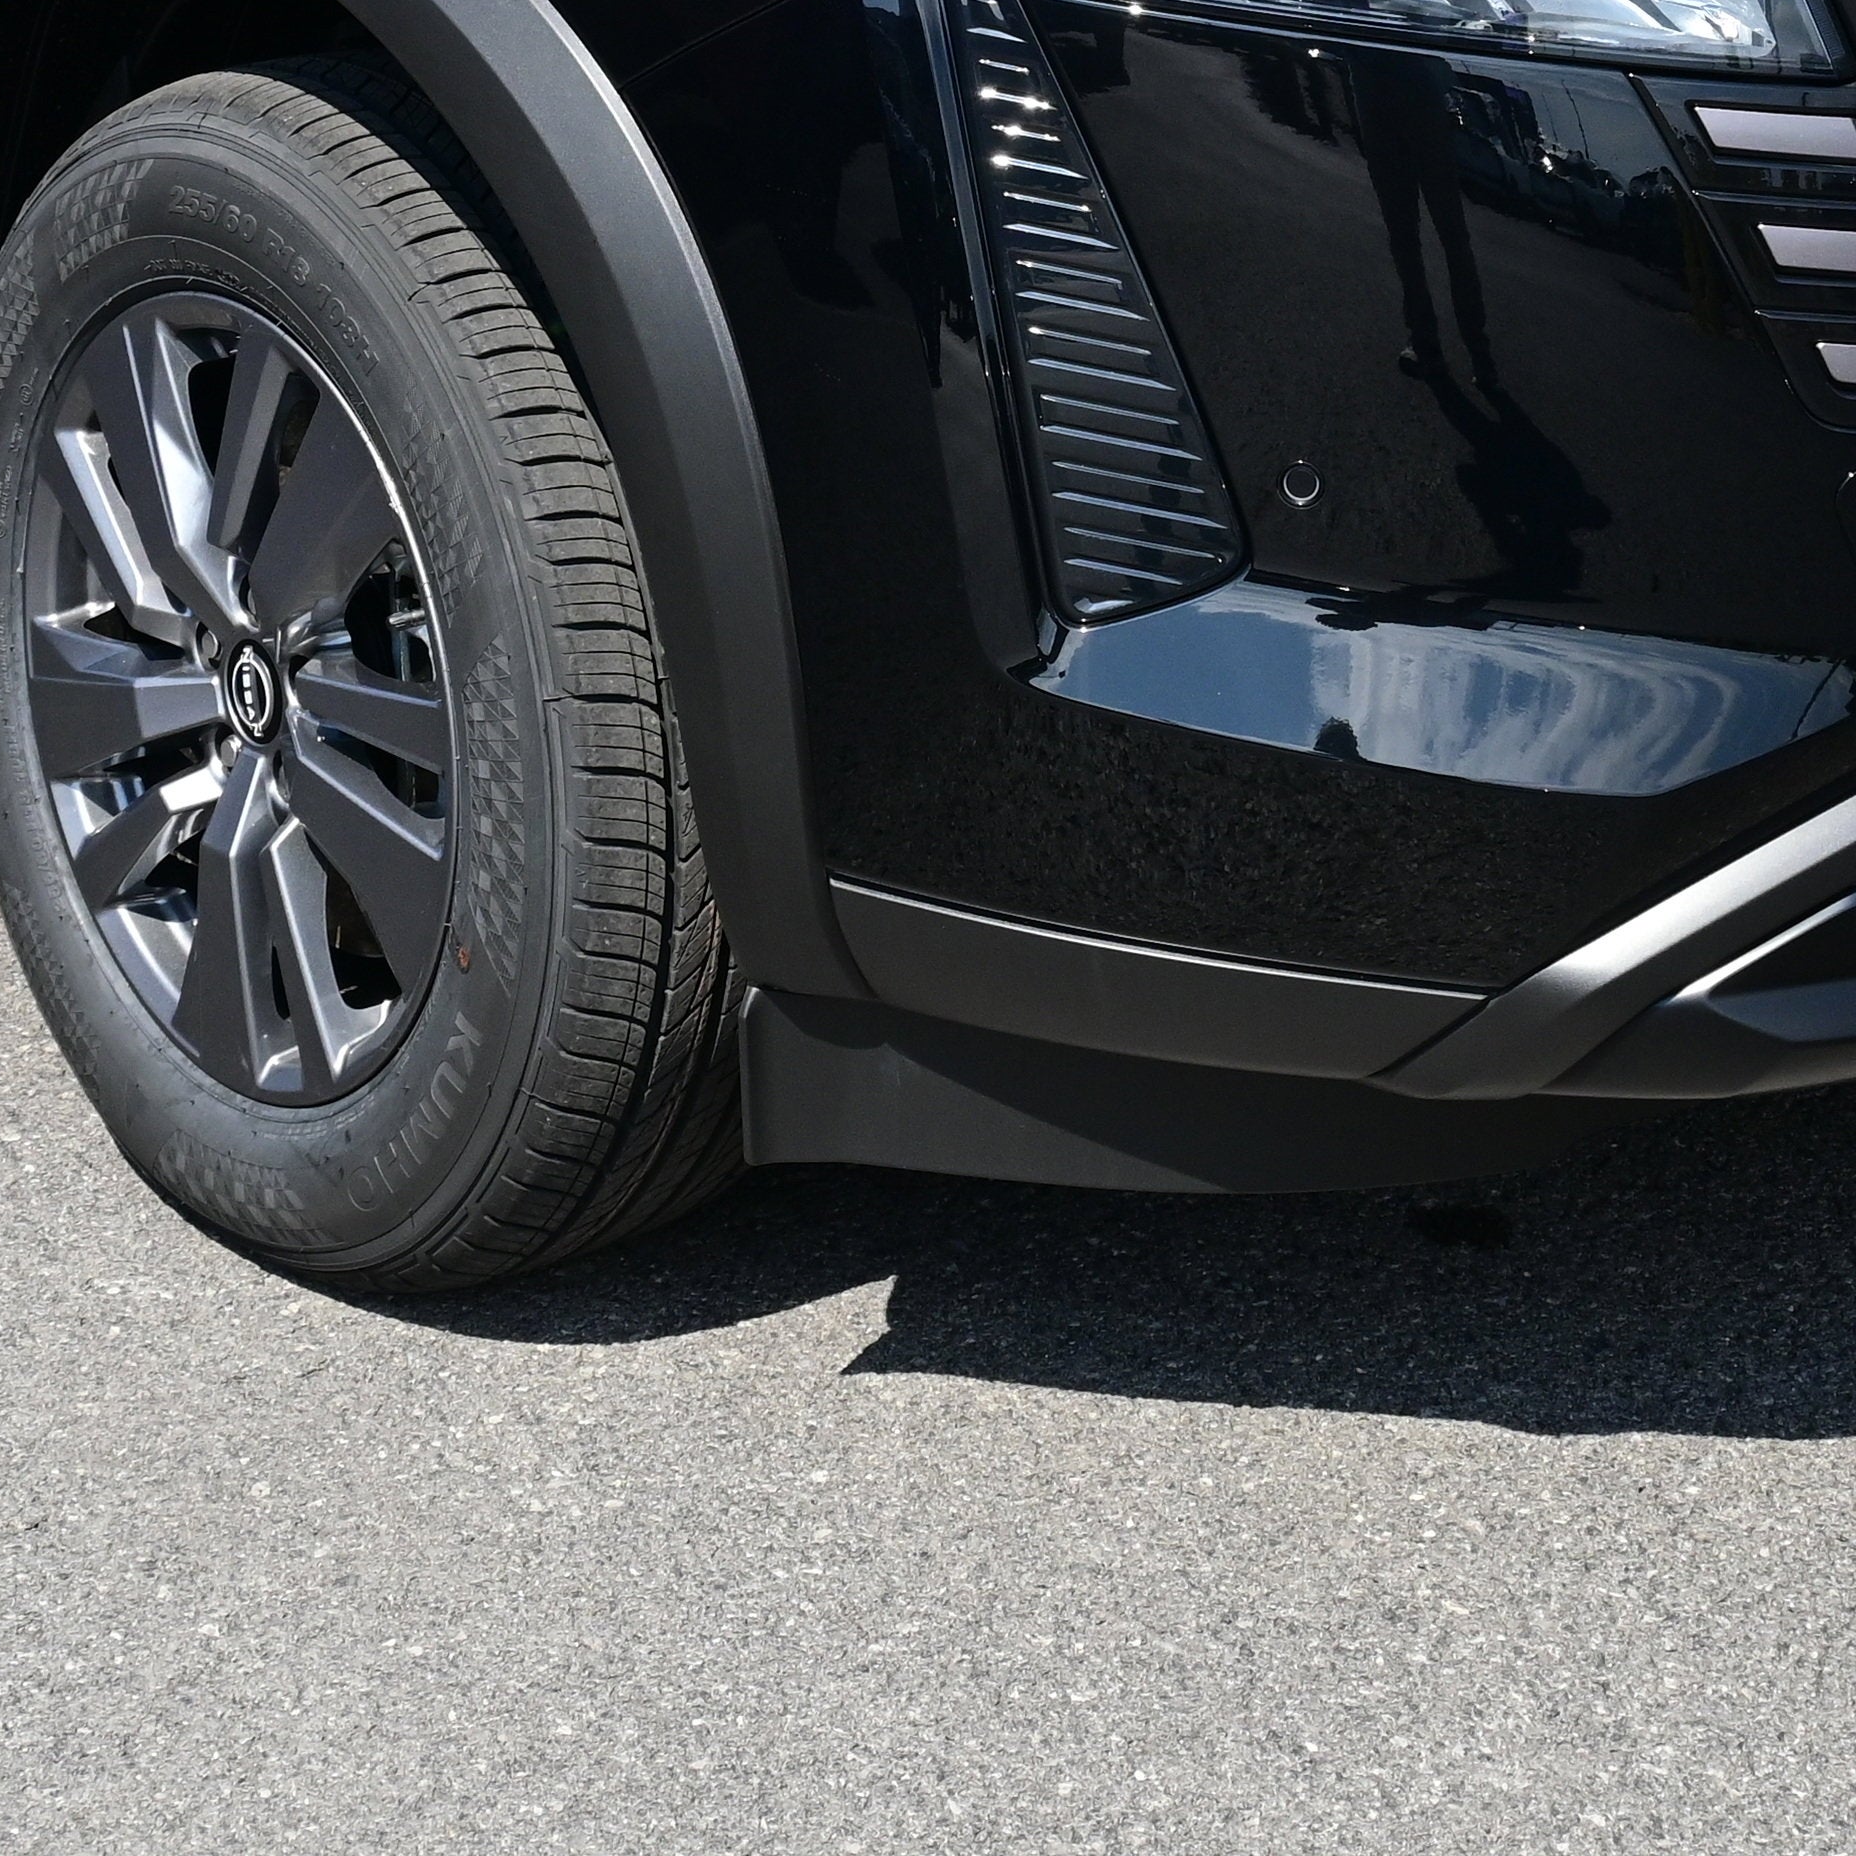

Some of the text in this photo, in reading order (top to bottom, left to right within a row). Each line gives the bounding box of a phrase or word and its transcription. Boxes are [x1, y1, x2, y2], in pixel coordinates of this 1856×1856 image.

[167, 184, 258, 243] 255/60
[263, 227, 311, 288] R18
[347, 1010, 484, 1213] KUMHO
